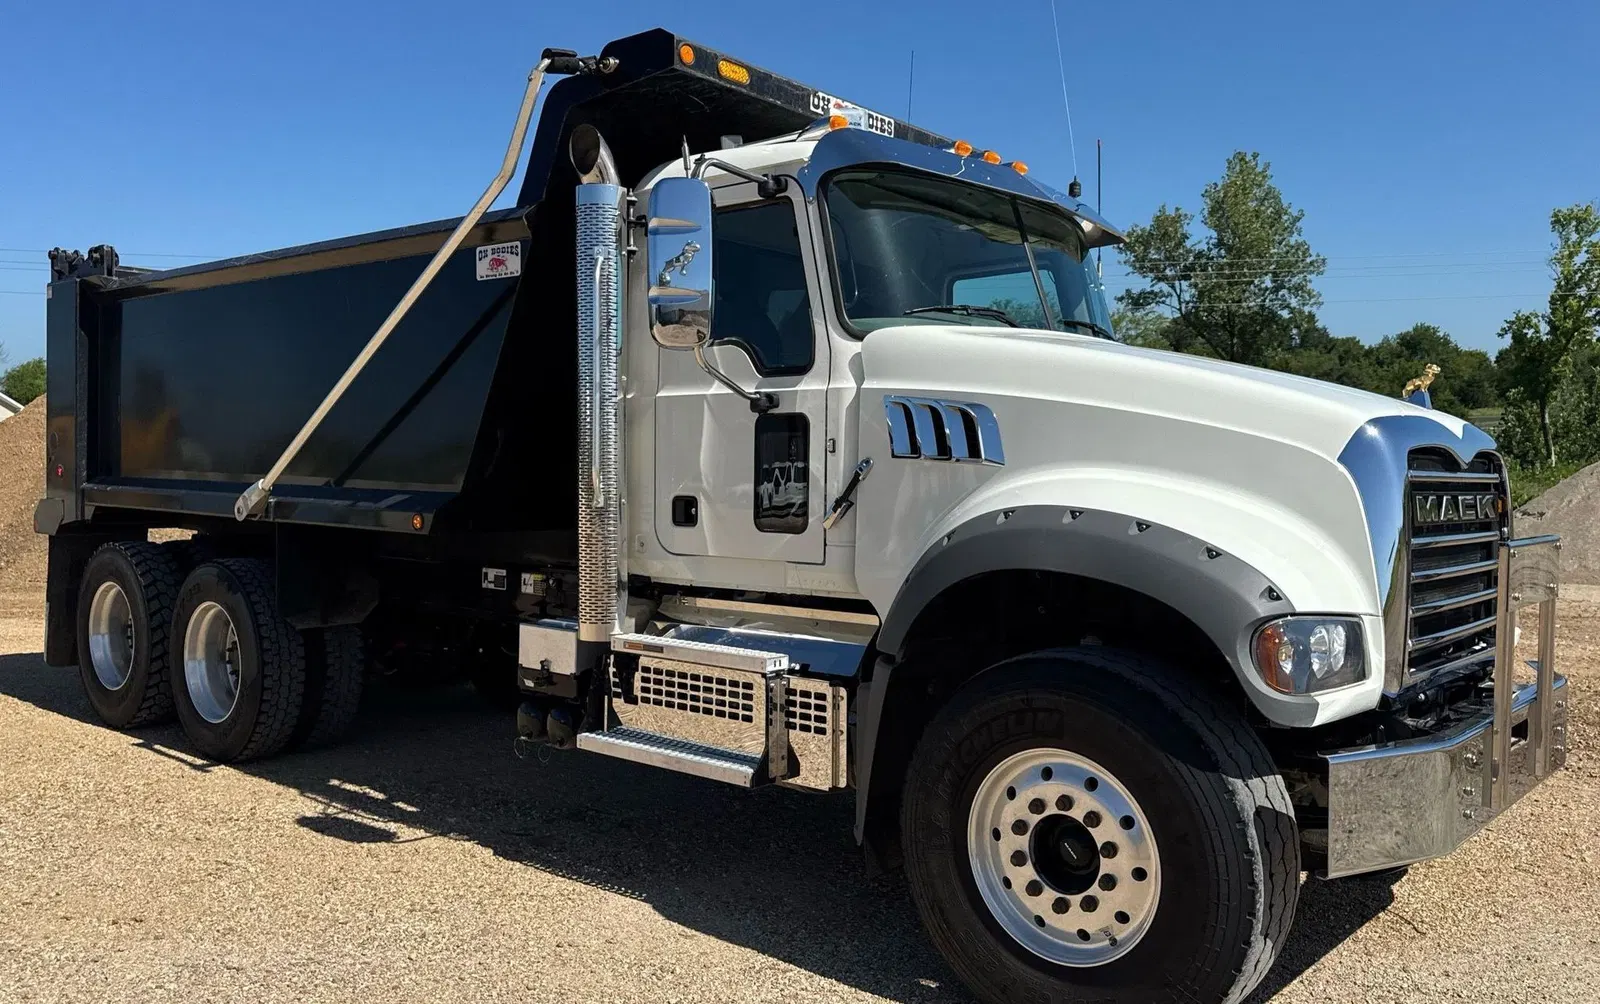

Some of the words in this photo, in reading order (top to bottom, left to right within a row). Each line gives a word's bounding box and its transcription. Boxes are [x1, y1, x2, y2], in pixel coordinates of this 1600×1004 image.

[812, 92, 831, 112] OX
[868, 113, 892, 136] DIES
[478, 249, 488, 261] OX
[491, 244, 519, 257] BODIES
[1416, 495, 1496, 521] MACK
